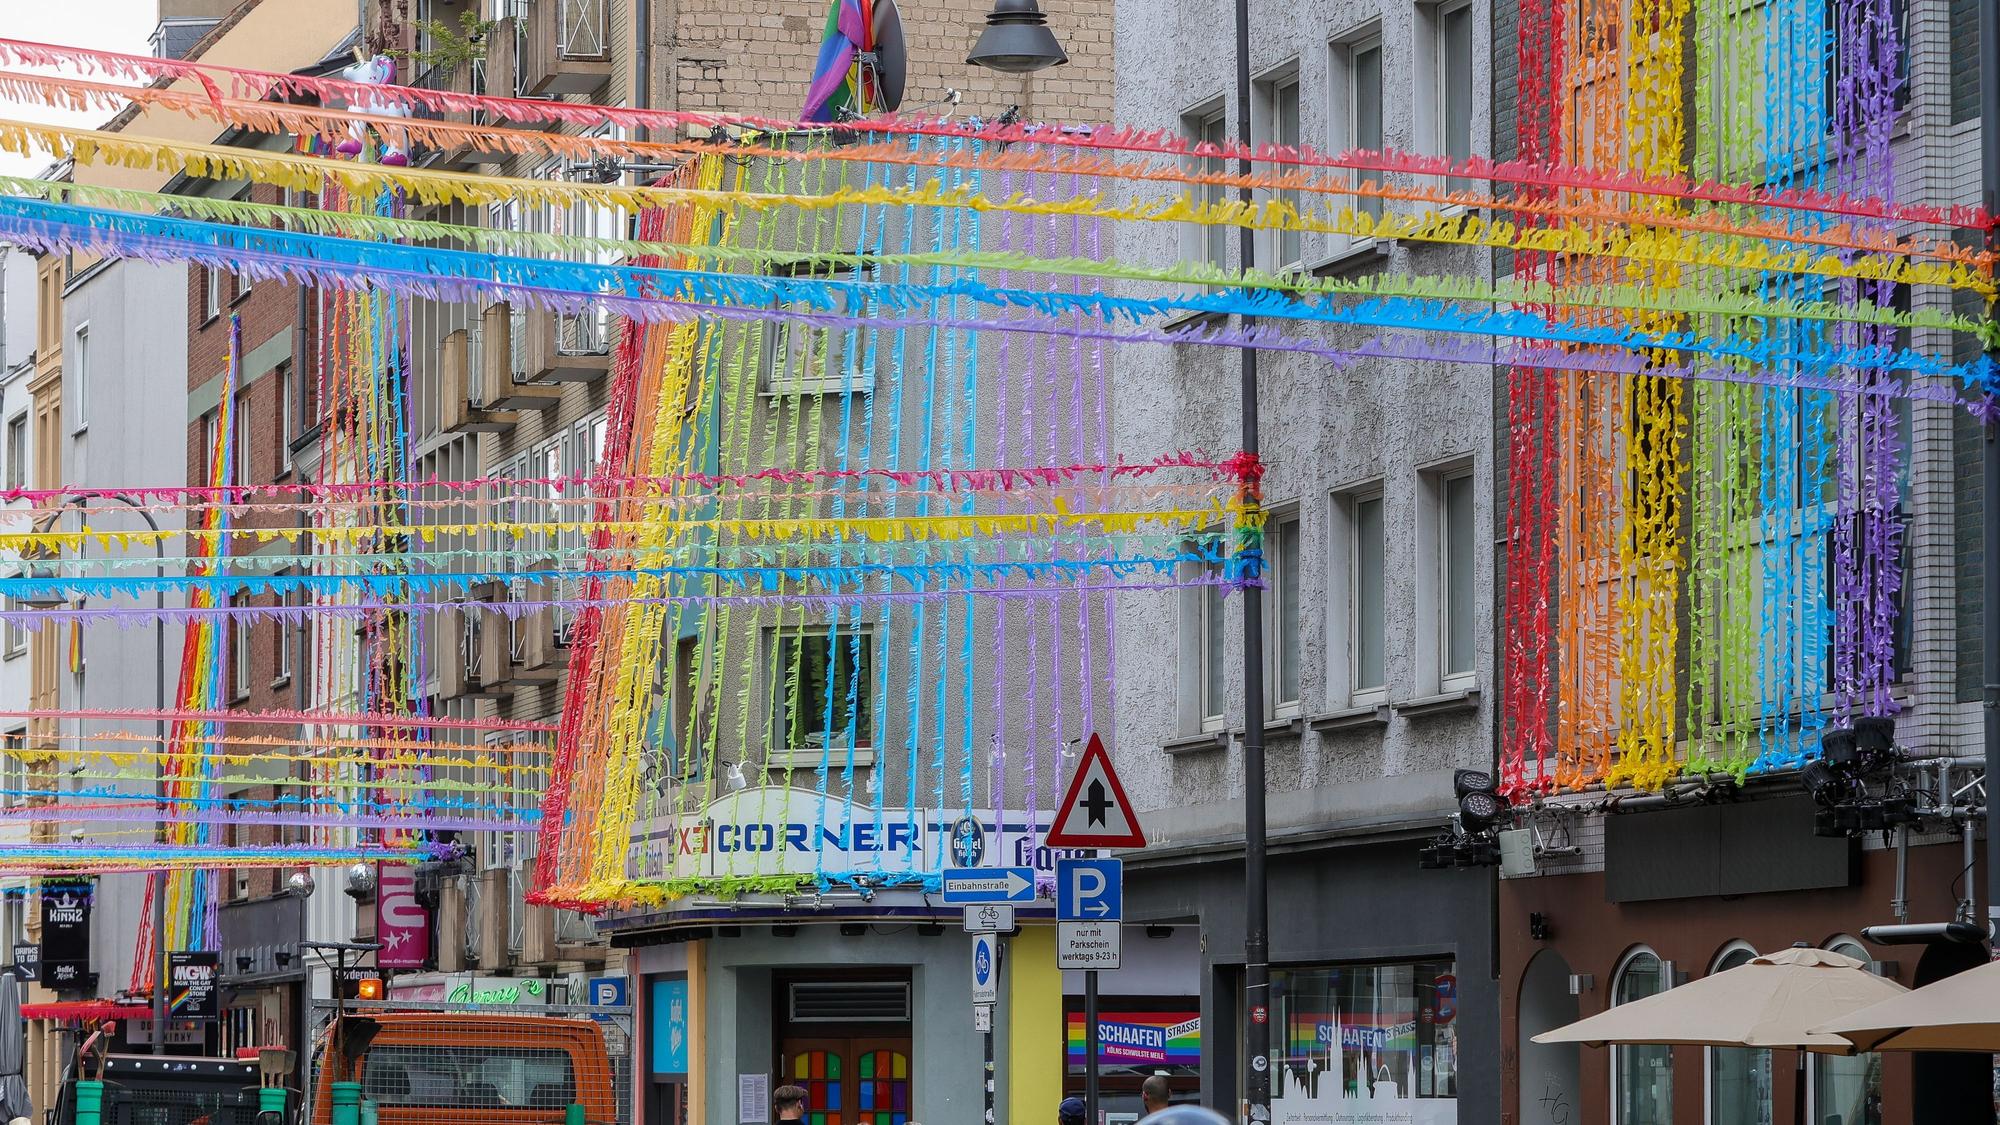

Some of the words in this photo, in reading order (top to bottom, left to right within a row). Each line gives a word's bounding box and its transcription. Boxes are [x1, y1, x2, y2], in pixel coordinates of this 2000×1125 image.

[718, 823, 924, 852] CORNER
[953, 837, 982, 850] Gael
[948, 881, 1010, 891] Einbahnstraße
[1072, 867, 1106, 917] P
[1089, 929, 1101, 937] mit
[1070, 940, 1109, 949] Parkschein
[1062, 953, 1094, 962] werktags
[1095, 952, 1111, 960] 9-23
[1112, 952, 1117, 960] h
[173, 965, 212, 981] MGW
[1098, 1023, 1163, 1048] SCHAAFEN
[1167, 1019, 1200, 1038] STRASSE
[1319, 1024, 1383, 1048] SCAAFEN
[1106, 1045, 1122, 1055] KÖLNS
[1122, 1048, 1150, 1058] SCHWULSTE
[1150, 1052, 1165, 1060] MEILE
